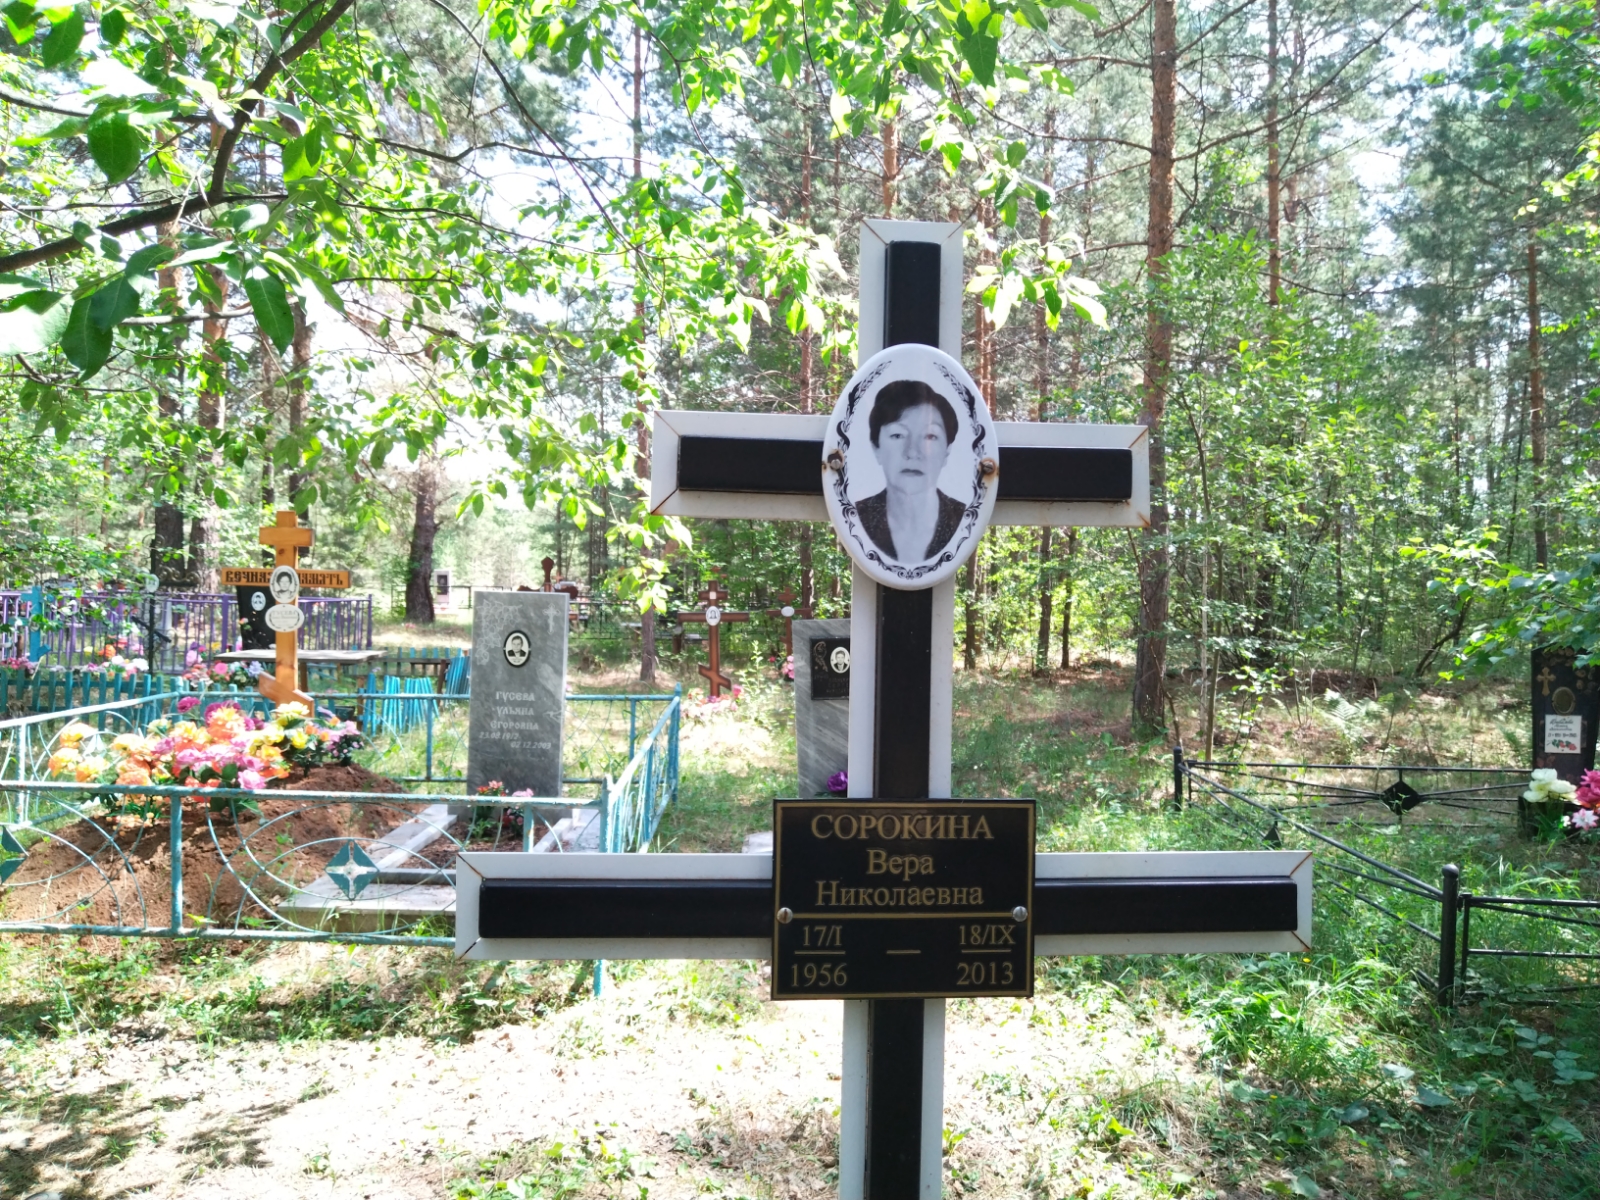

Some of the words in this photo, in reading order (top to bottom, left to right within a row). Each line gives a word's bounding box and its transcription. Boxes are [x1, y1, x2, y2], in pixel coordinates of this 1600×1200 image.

[811, 814, 994, 839] СОРОКИНА
[866, 848, 935, 881] Вера
[815, 880, 984, 906] Николаевна
[802, 925, 843, 946] 17/I
[959, 924, 1016, 945] 18/IX
[791, 963, 847, 987] 1956
[956, 962, 1014, 986] 2013
